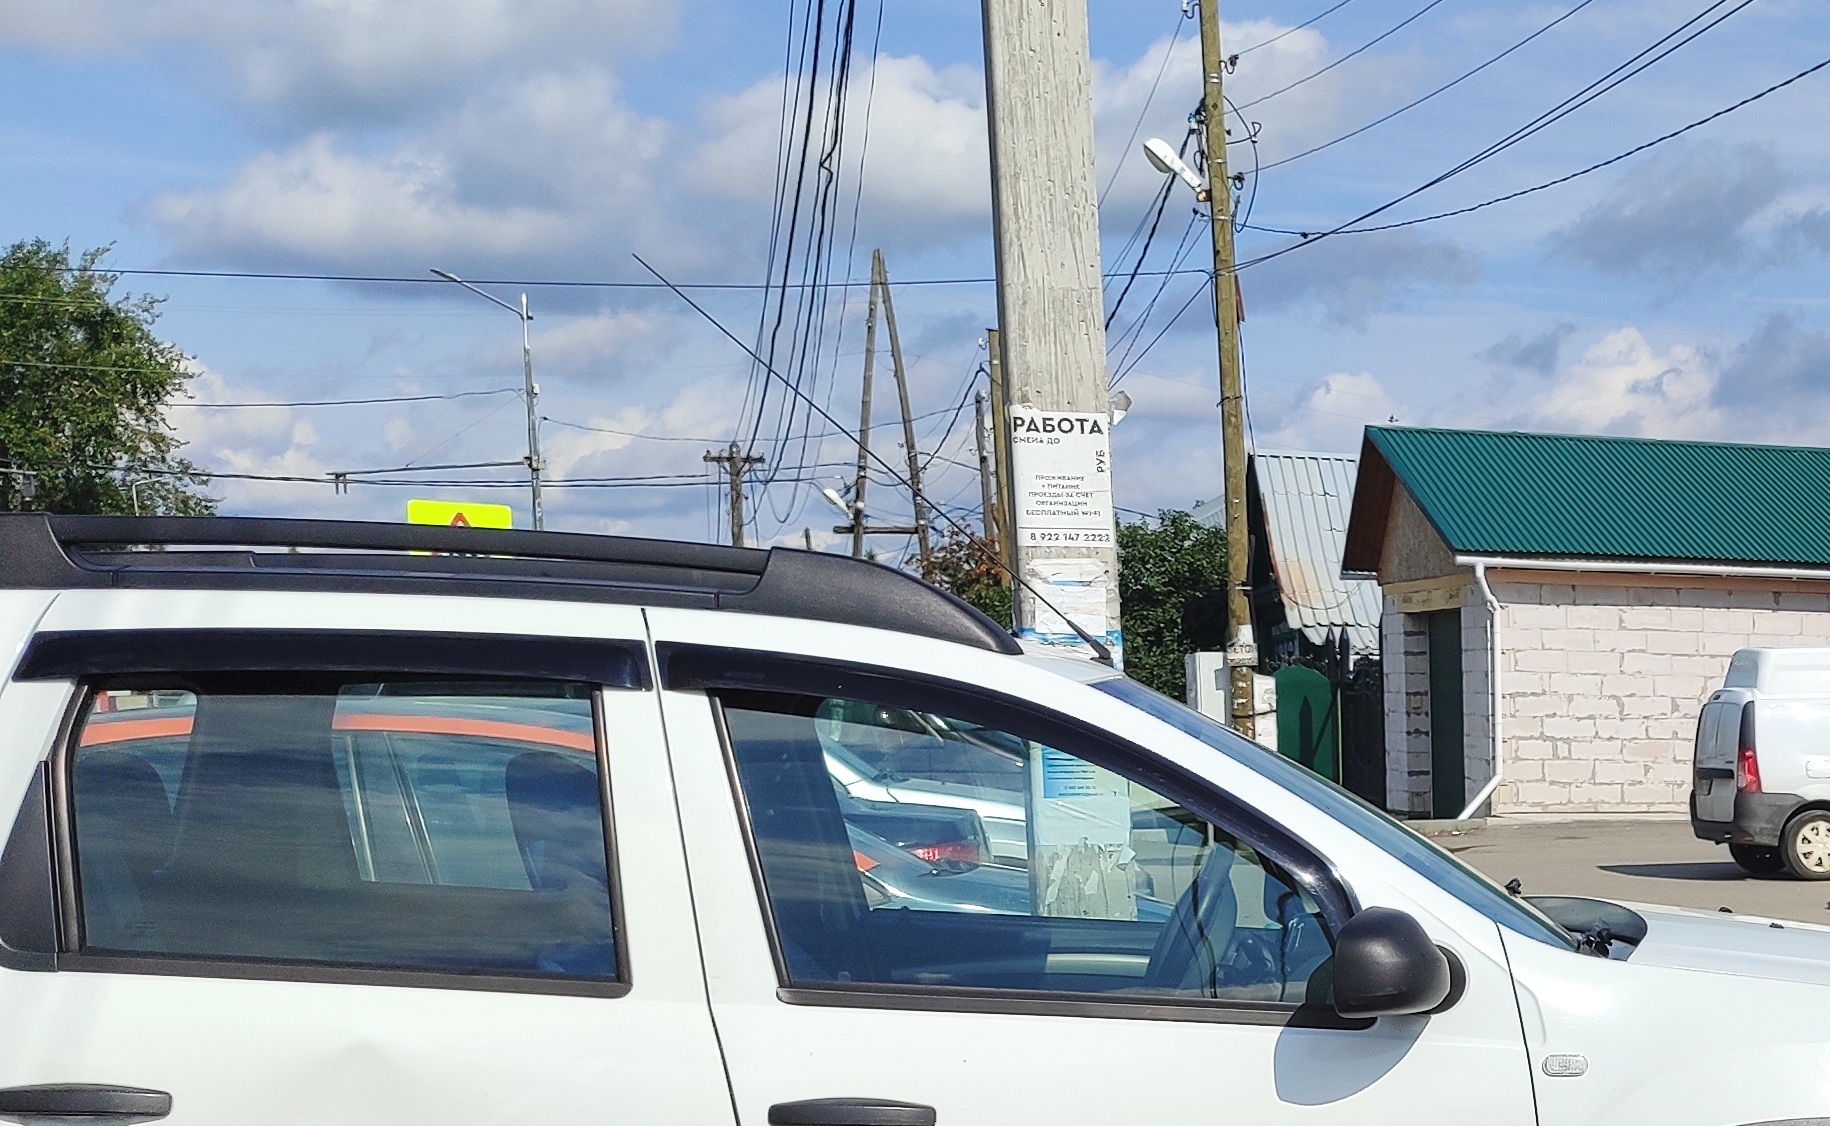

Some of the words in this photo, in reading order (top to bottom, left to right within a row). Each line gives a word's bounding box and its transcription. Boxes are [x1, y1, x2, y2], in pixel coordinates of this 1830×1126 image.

[1013, 416, 1104, 435] РАБОТА
[1046, 437, 1061, 446] ДО
[1095, 449, 1106, 474] РУБ
[1030, 532, 1036, 541] 8
[1040, 532, 1060, 541] 922
[1062, 533, 1080, 541] 147
[1083, 534, 1111, 543] 2222
